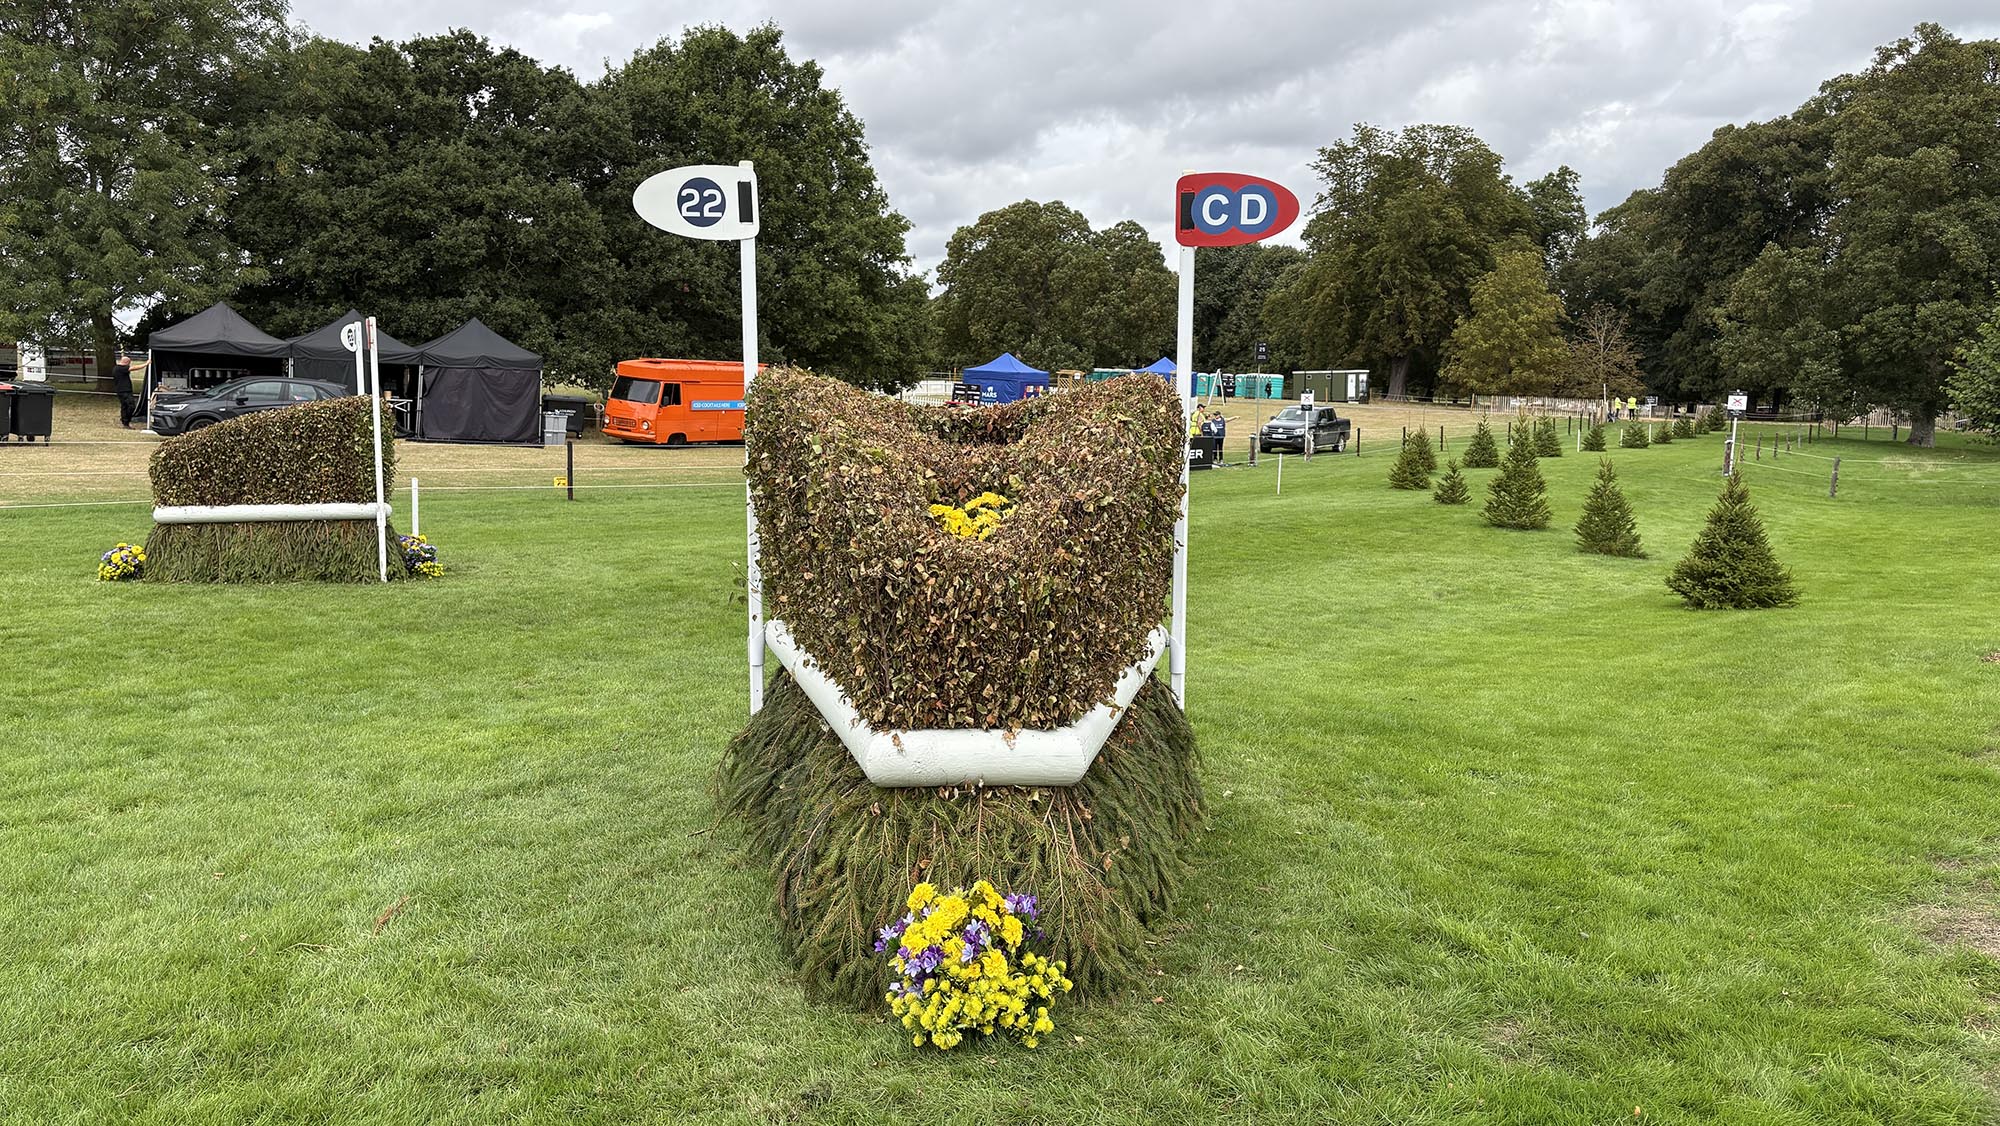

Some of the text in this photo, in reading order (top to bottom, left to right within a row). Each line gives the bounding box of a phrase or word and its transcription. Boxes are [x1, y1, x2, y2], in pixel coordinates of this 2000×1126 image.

[680, 188, 722, 218] 22
[1202, 193, 1268, 226] C D
[981, 391, 998, 399] MARS
